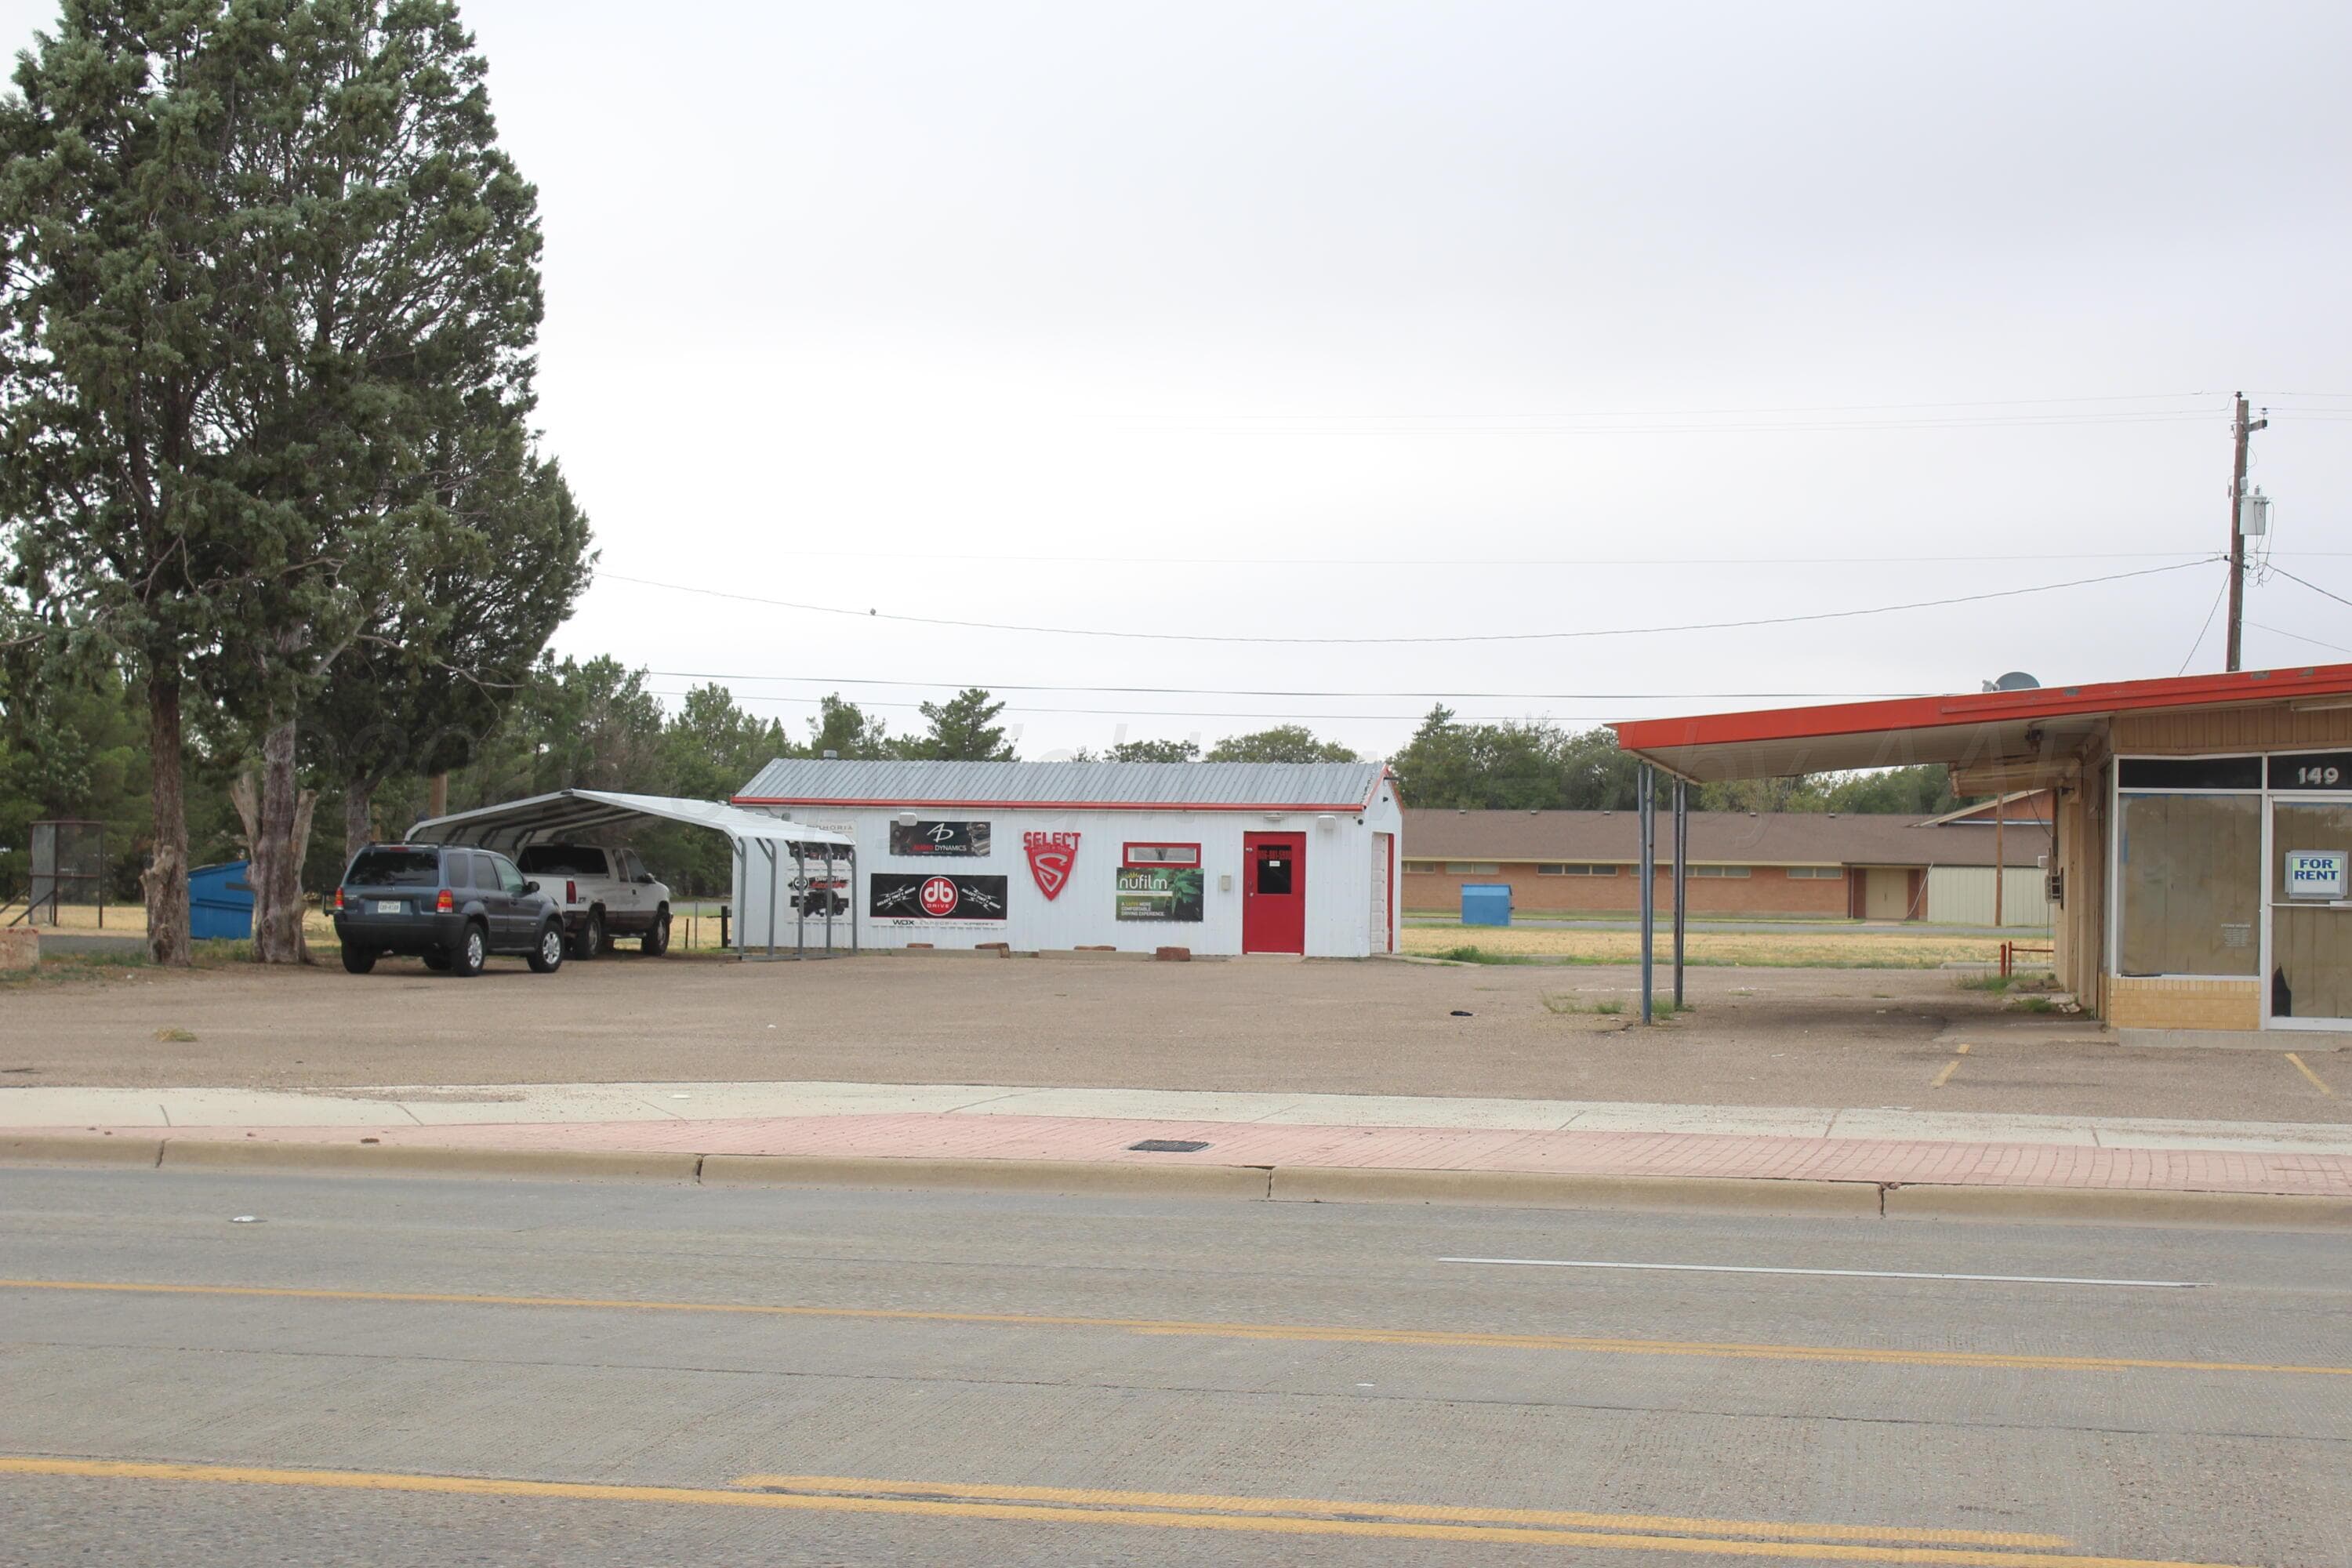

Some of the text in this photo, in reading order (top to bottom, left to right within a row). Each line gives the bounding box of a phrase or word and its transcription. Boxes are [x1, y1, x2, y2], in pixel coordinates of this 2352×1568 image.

[2298, 767, 2339, 785] 149
[1023, 831, 1081, 851] SELECT
[2299, 858, 2333, 869] FOR
[1119, 873, 1167, 890] nufilm
[2294, 870, 2339, 880] RENT
[924, 881, 953, 902] db
